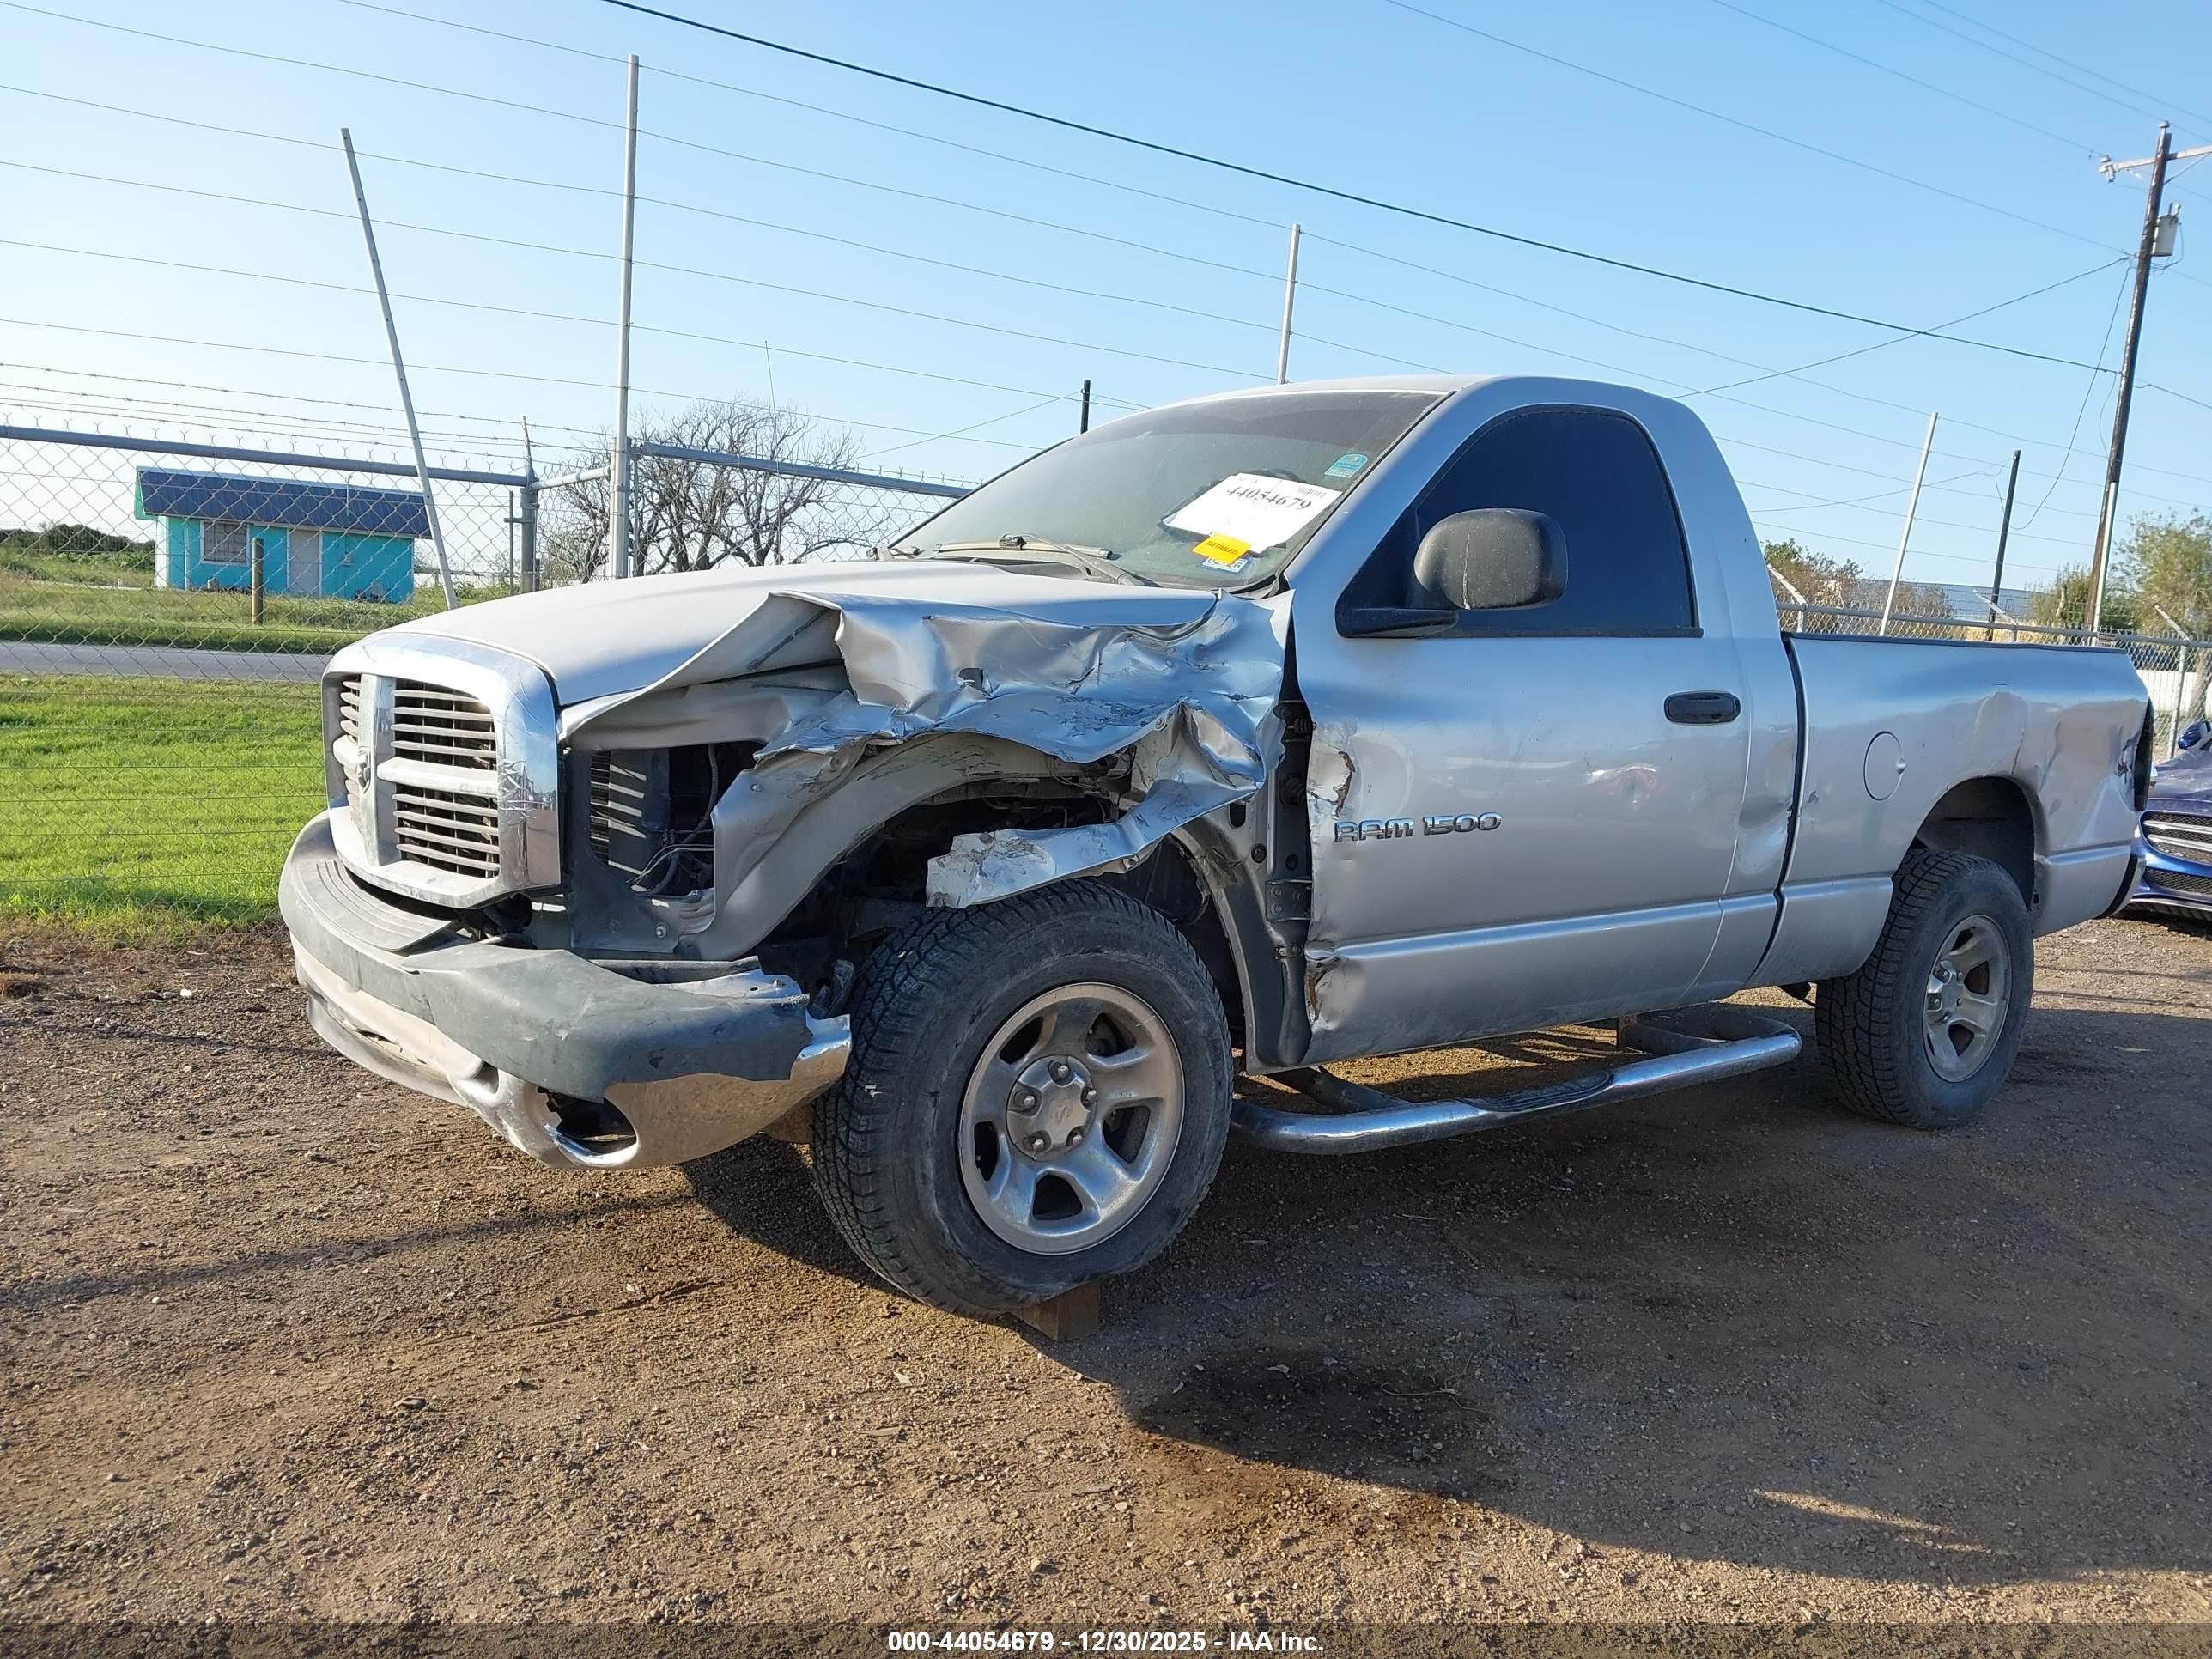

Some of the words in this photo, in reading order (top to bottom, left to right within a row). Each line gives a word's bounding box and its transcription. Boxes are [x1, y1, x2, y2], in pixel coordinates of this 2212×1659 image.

[1227, 487, 1312, 509] 44054679
[1206, 540, 1238, 555] DETAILED
[1334, 817, 1415, 843] RAM
[1422, 811, 1504, 836] 1500
